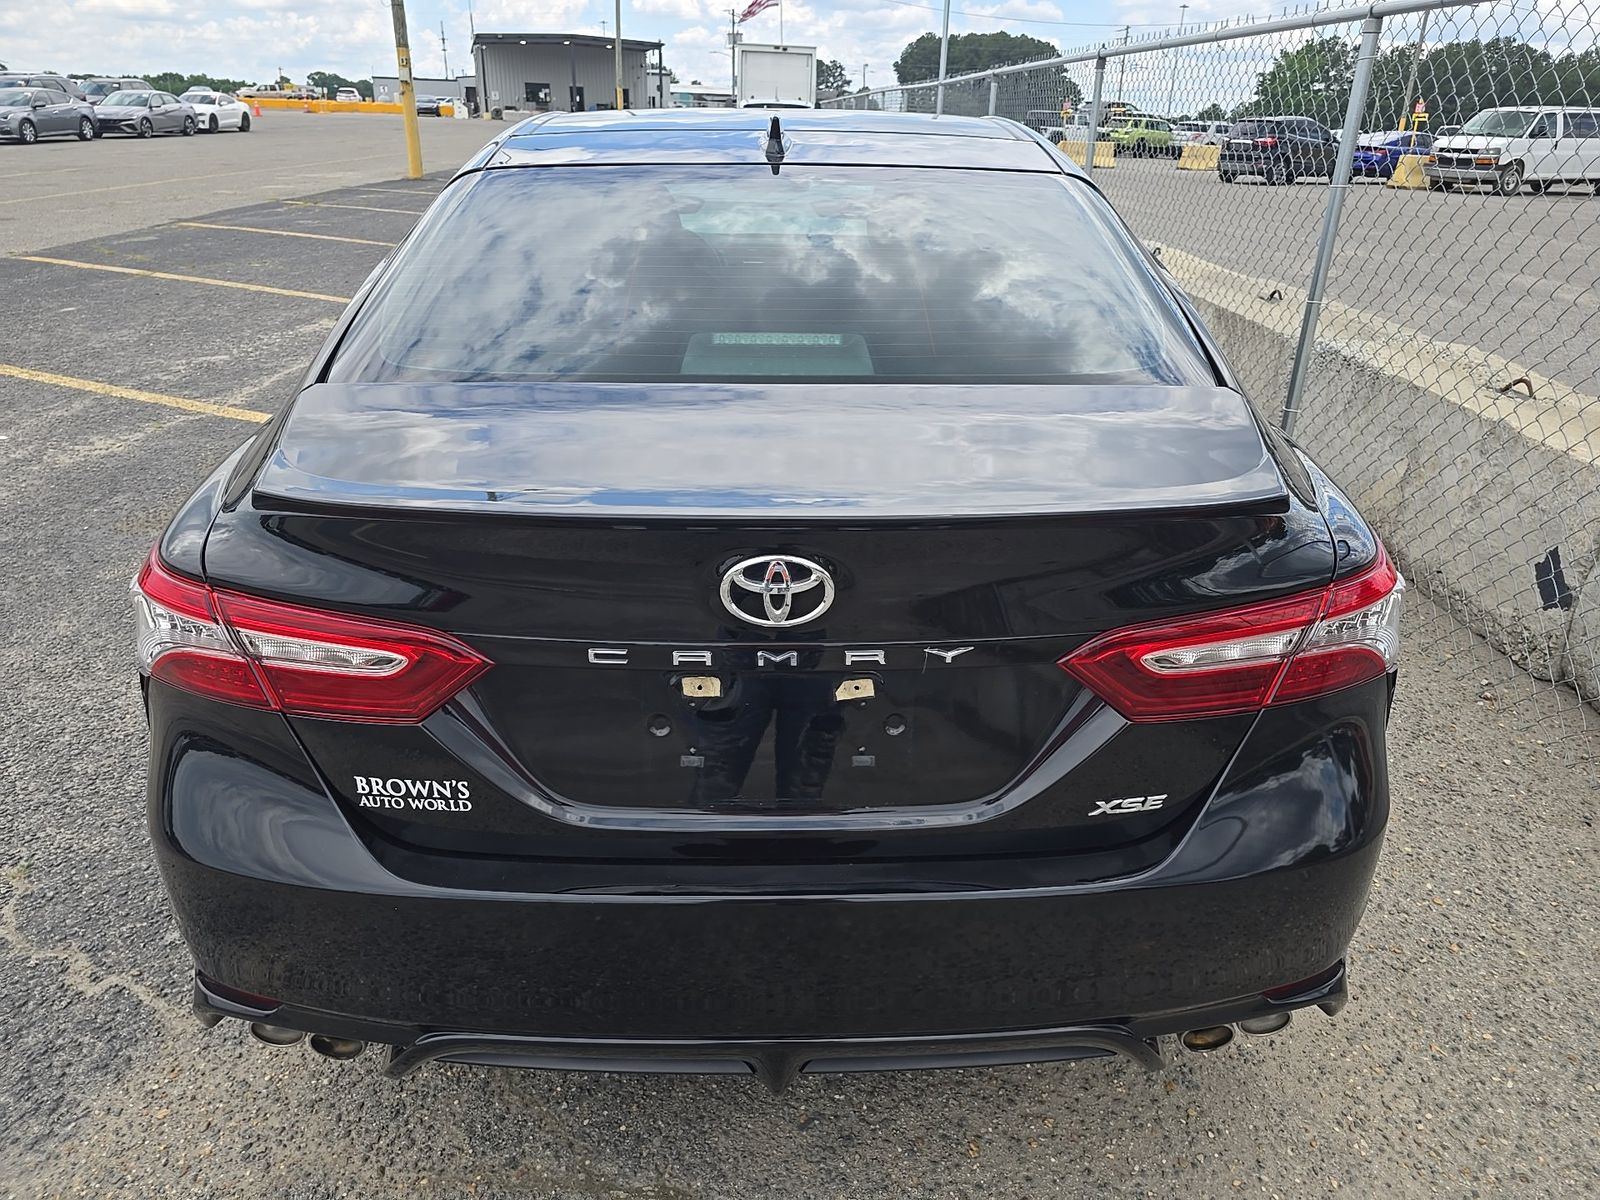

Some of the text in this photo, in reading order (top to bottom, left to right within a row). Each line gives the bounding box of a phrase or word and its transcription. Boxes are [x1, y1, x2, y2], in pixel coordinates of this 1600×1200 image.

[588, 646, 975, 666] CAMRY
[353, 775, 470, 799] BROWN'S
[359, 795, 472, 812] AUTO WORLD
[1087, 793, 1168, 817] XSE
